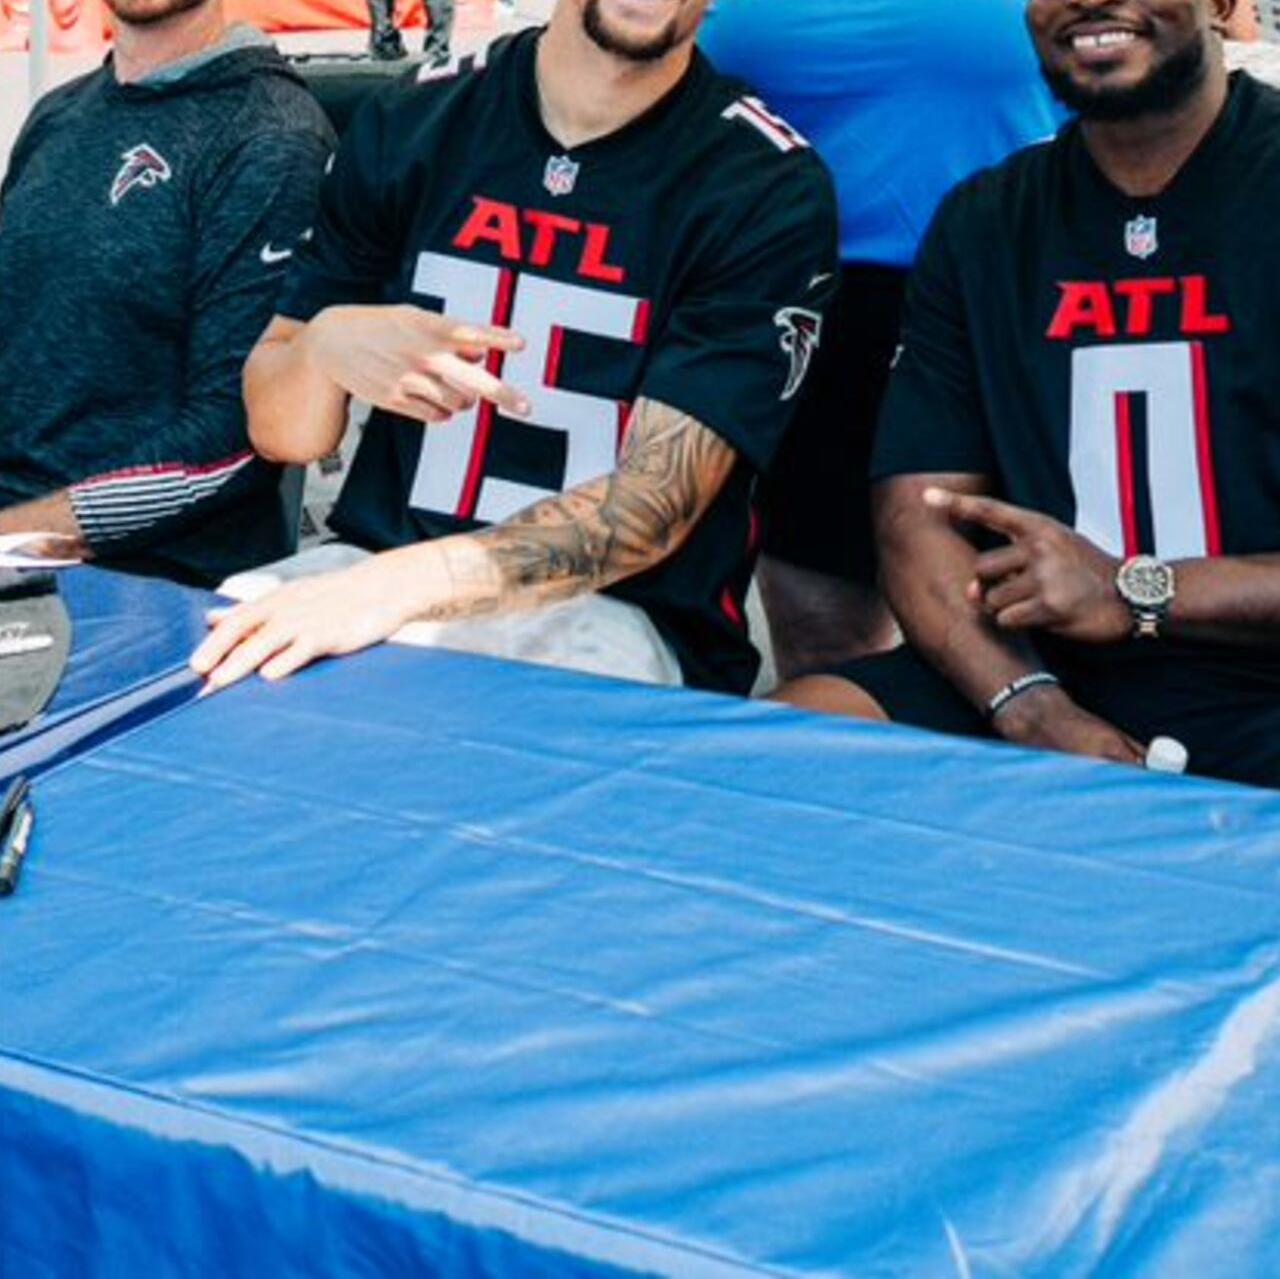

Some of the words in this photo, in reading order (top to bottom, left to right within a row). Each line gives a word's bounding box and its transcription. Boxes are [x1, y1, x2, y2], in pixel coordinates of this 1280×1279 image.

[453, 195, 626, 284] ATL
[1045, 275, 1232, 340] ATL
[410, 250, 652, 525] 15
[1068, 341, 1221, 559] 0
